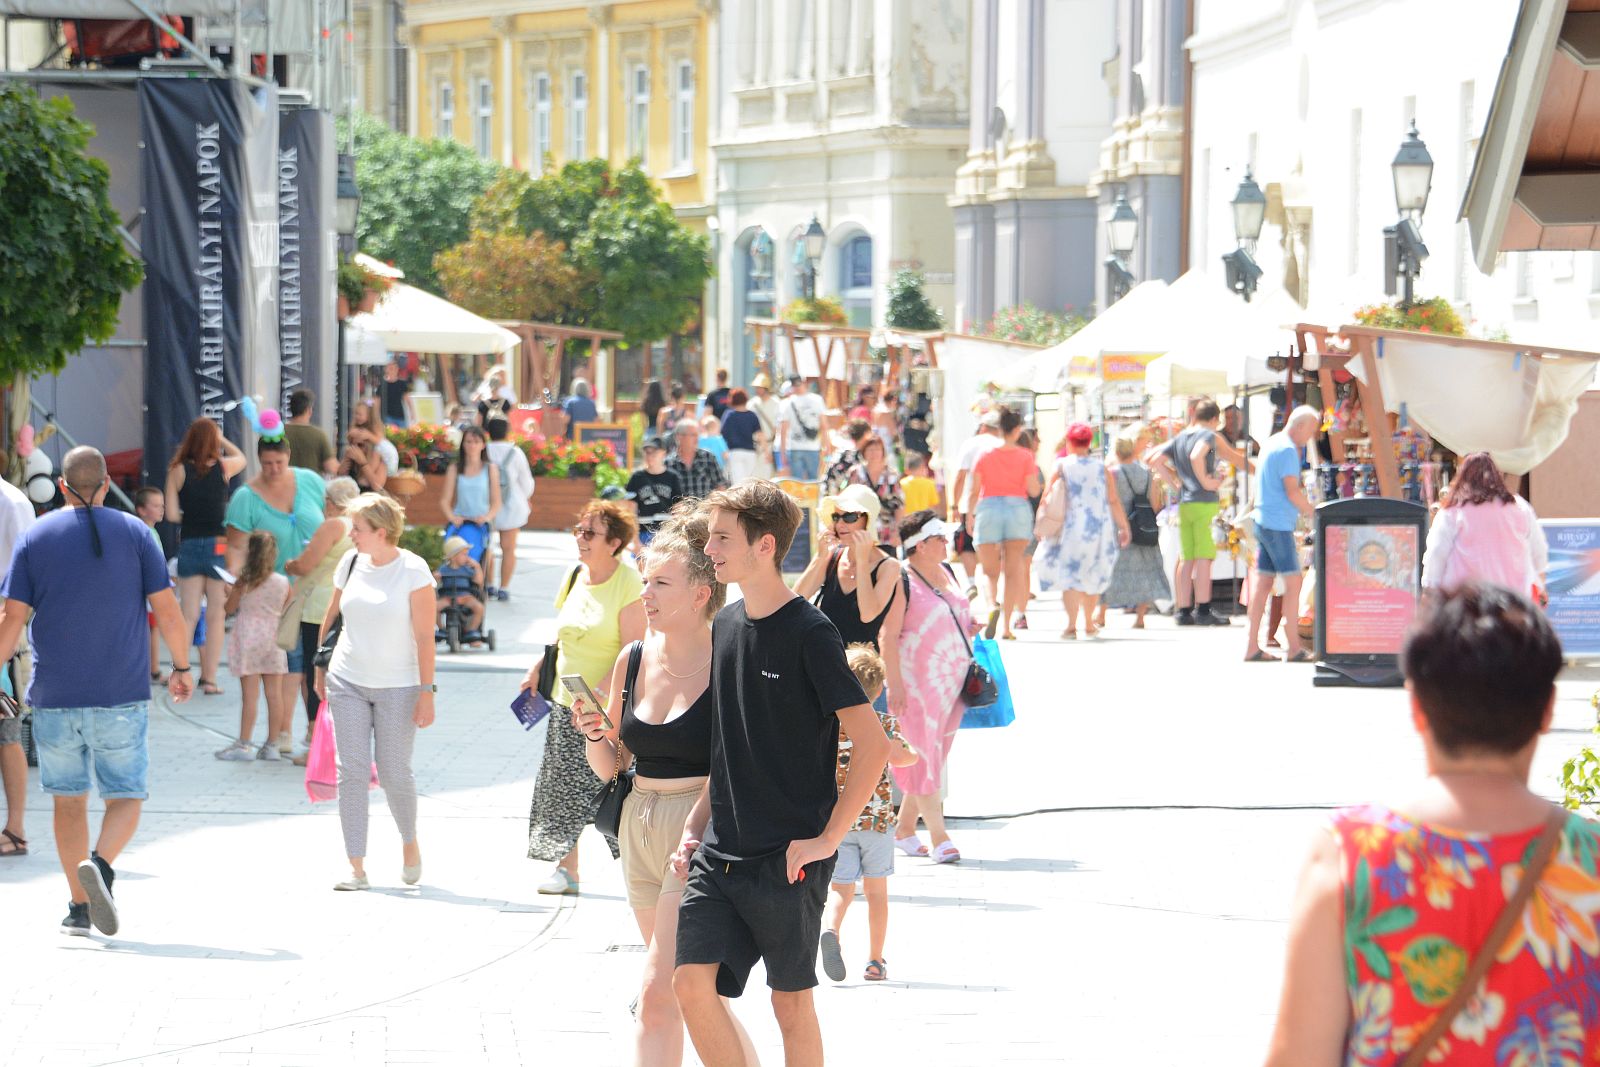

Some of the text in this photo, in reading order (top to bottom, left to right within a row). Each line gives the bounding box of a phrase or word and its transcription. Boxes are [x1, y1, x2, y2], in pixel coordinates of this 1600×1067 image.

[194, 122, 224, 433] RVÁRI KIRÁLYI NAPOK
[278, 146, 300, 226] NAPOK
